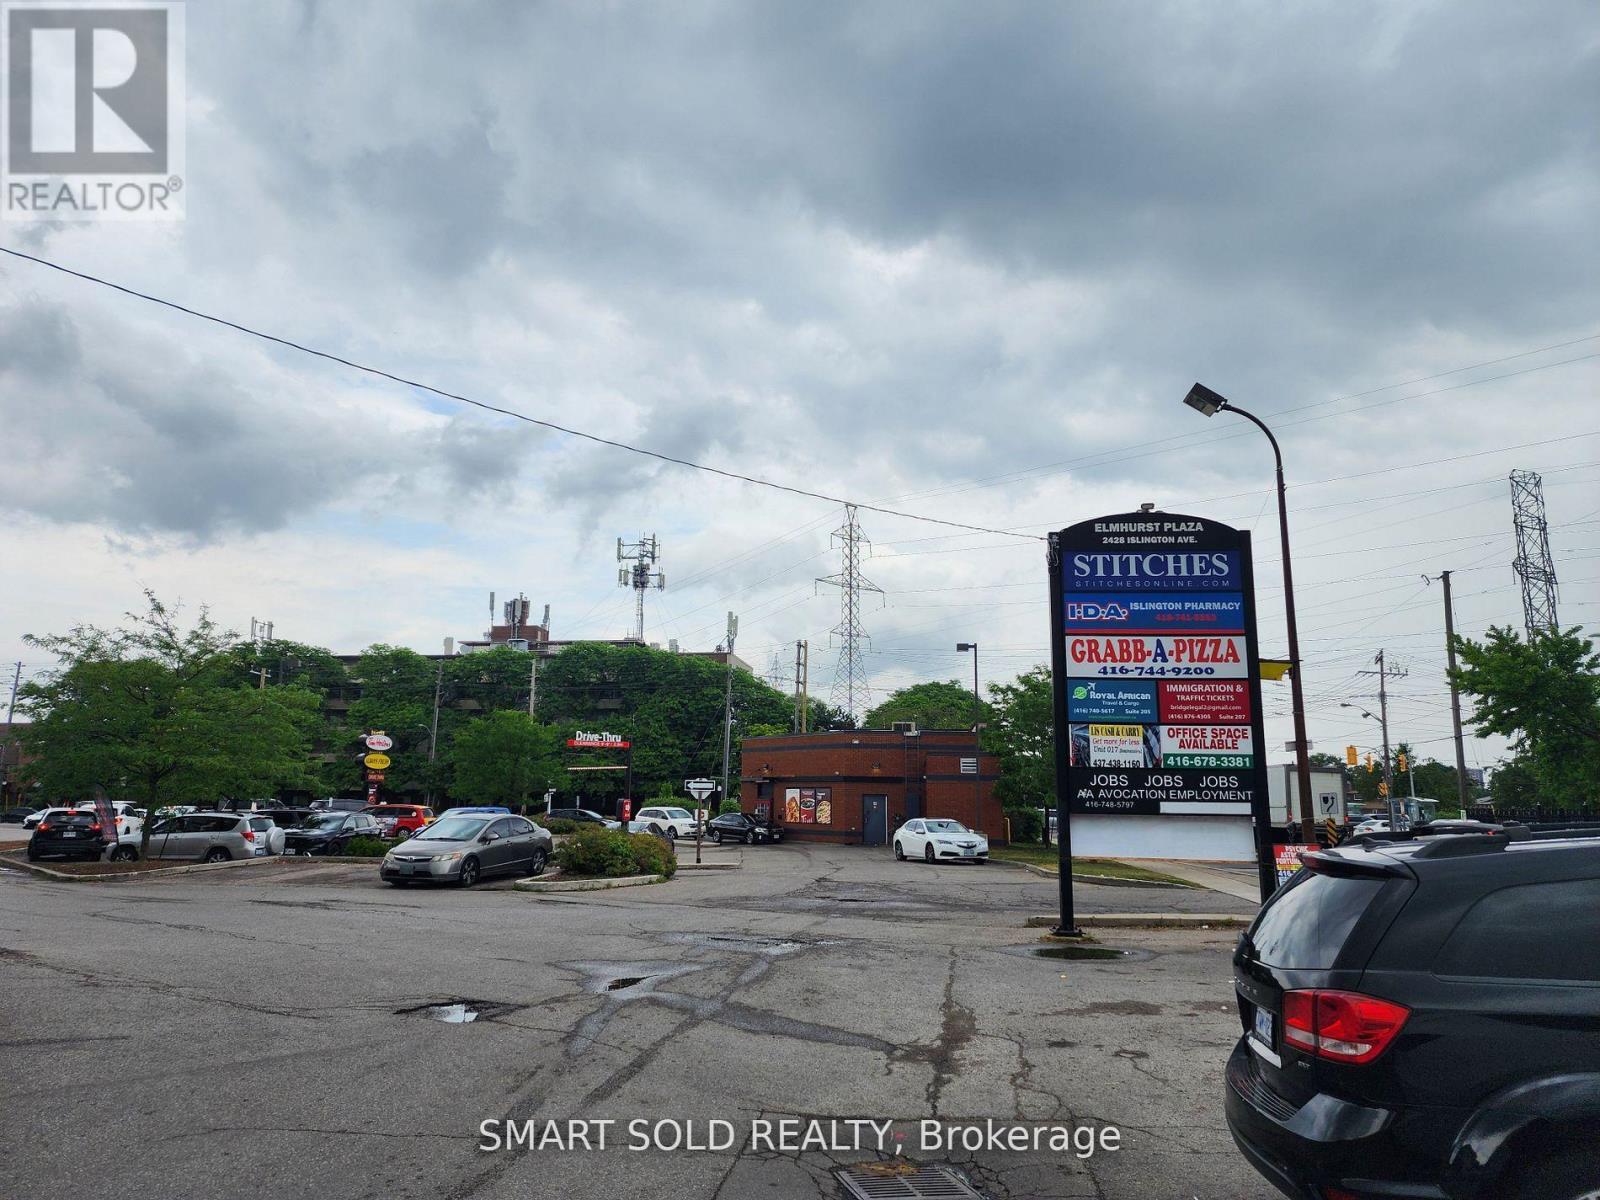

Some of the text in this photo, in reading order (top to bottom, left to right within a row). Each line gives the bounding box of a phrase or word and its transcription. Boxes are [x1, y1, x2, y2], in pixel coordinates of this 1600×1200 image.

[1094, 521, 1205, 533] ELMHURST PLAZA
[1102, 535, 1198, 544] 2428 ISLINGTON AVE.
[1073, 553, 1230, 578] STITCHES
[1075, 580, 1230, 588] STITCHESONLINE.COM
[1130, 602, 1241, 611] ISLINGTON PHARMACY
[1070, 638, 1241, 664] GRABB-A-PIZZA
[1097, 665, 1216, 677] 416-744-9200
[1166, 684, 1244, 693] IMMIGRATION &
[575, 730, 622, 743] Drive-Thru
[1101, 726, 1116, 736] CASH
[1116, 727, 1121, 736] &
[1122, 726, 1141, 737] CARRY
[1167, 727, 1249, 740] OFFICE SPACE
[1178, 738, 1239, 750] AVAILABLE
[1166, 756, 1251, 768] 416-678-3381
[1090, 774, 1240, 788] JOBS JOBS JOBS
[1097, 789, 1167, 800] AVOCATION
[1169, 790, 1253, 801] EMPLOYMENT
[1284, 845, 1308, 853] PSYCHIC
